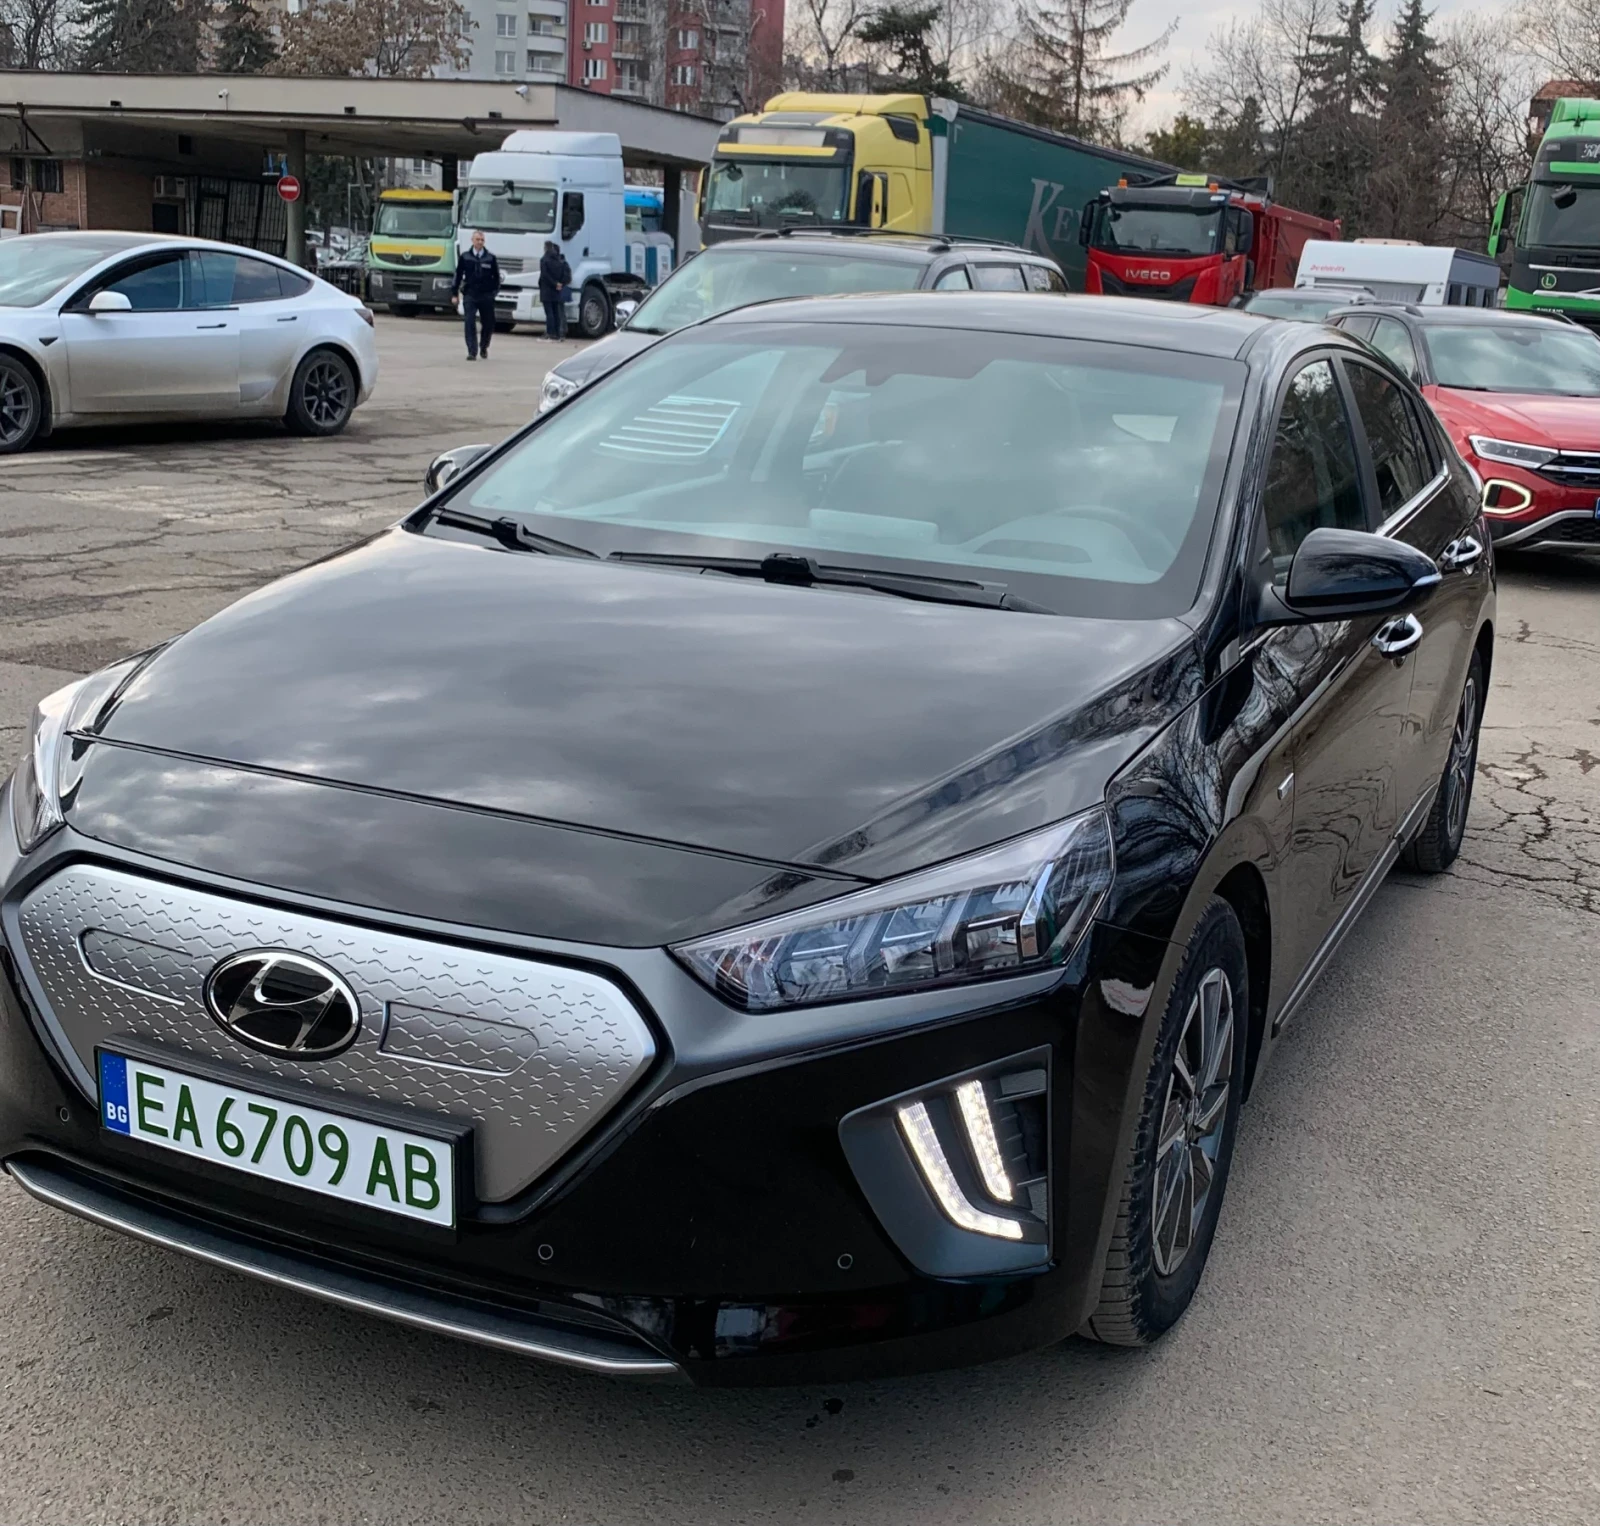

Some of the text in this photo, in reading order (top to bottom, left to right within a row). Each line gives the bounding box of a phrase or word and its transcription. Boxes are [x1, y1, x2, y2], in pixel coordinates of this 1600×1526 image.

[1021, 178, 1083, 260] KE
[1125, 268, 1170, 280] IVECO
[106, 1101, 128, 1124] BG
[136, 1071, 440, 1210] EA 6709 AB
